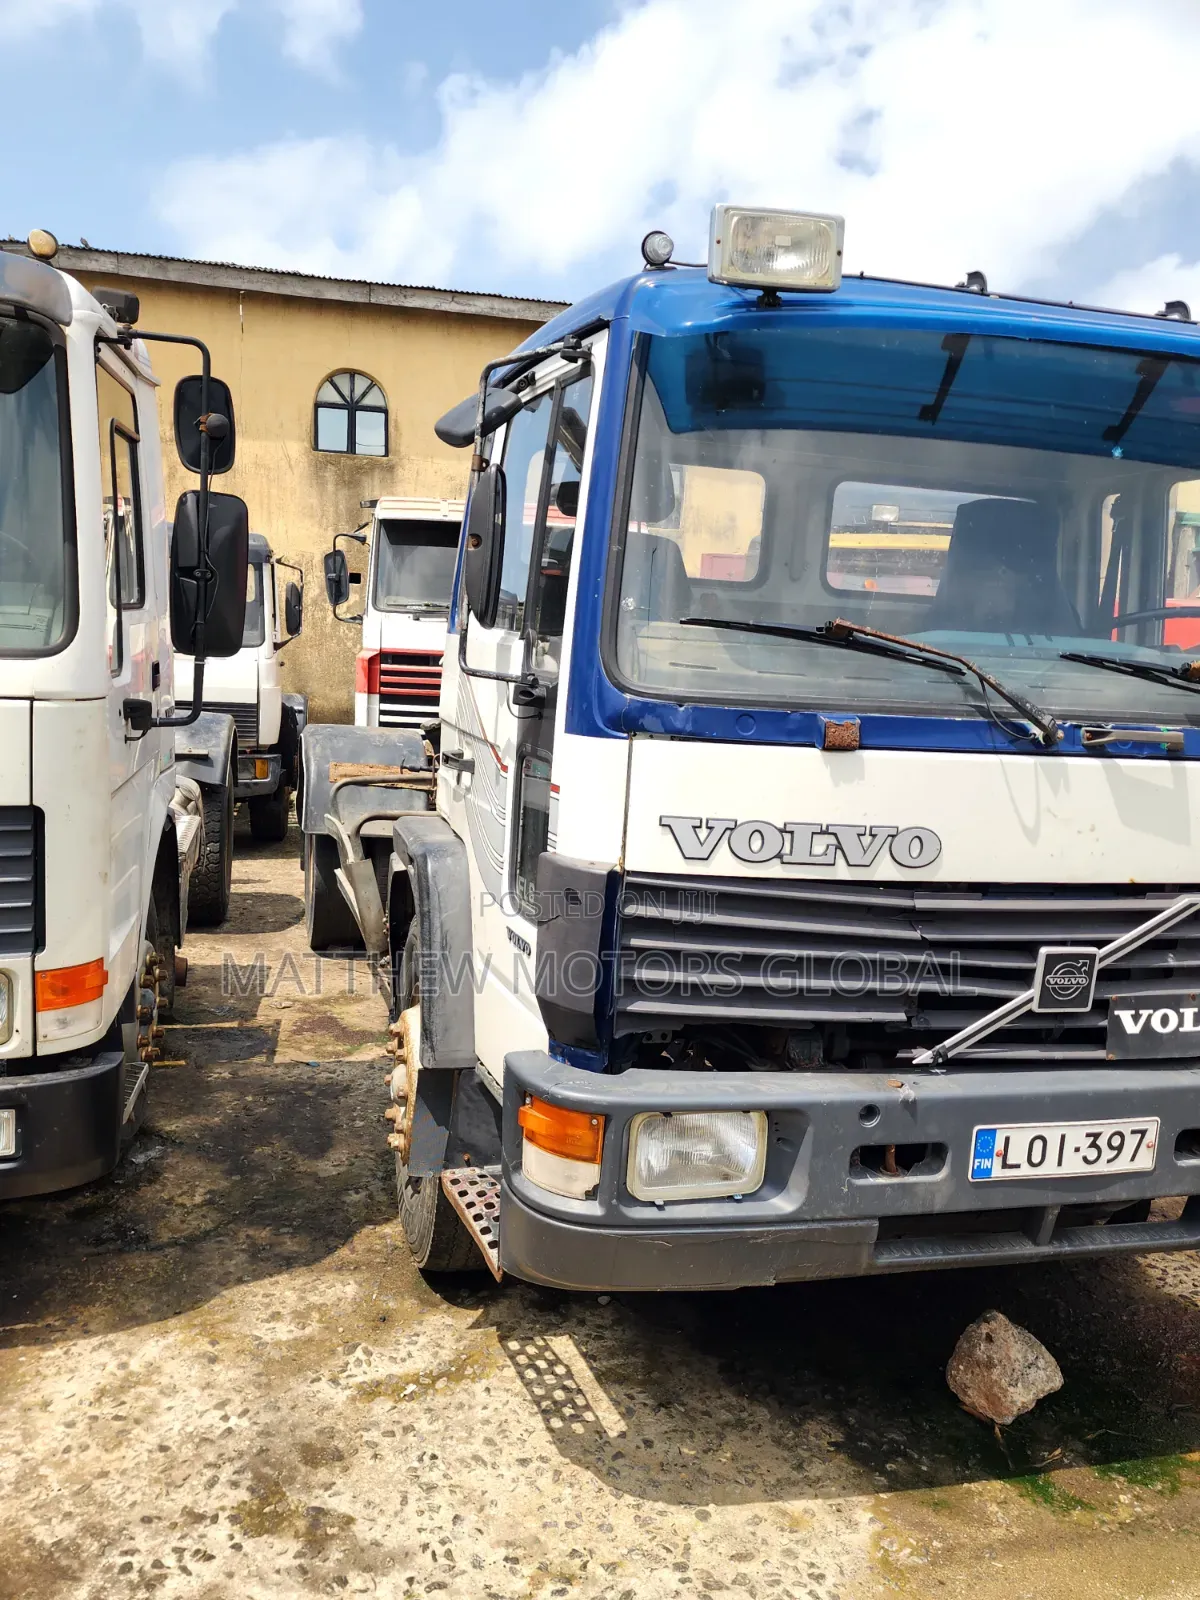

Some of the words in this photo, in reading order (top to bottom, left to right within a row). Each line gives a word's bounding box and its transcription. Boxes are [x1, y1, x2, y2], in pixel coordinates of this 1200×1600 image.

[659, 815, 942, 868] VOLVO
[506, 926, 532, 957] VOLVO
[1048, 976, 1087, 985] VOLVO
[1114, 1007, 1200, 1034] VOL
[974, 1158, 992, 1170] FIN
[1001, 1127, 1150, 1170] LOI-397
